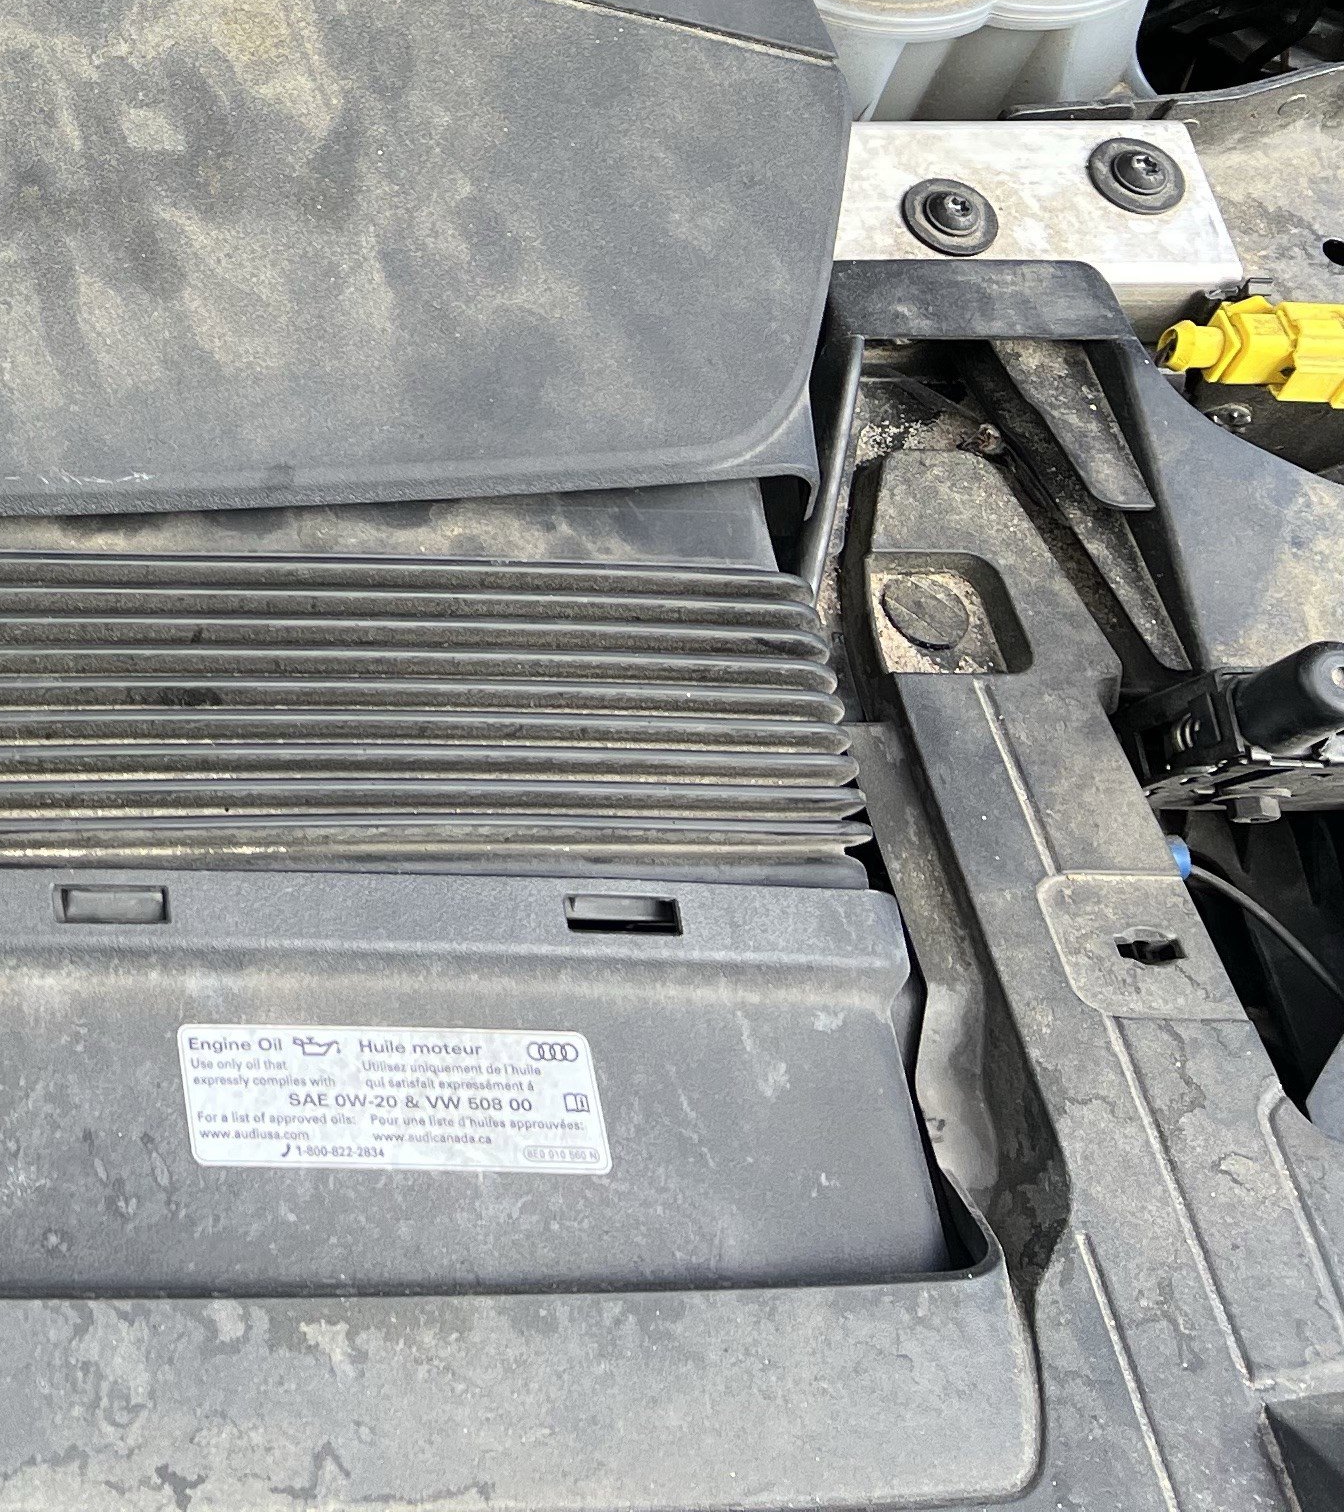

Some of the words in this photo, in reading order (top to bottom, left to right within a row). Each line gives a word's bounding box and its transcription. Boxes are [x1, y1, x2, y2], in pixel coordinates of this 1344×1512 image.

[188, 1037, 252, 1053] Engine
[258, 1037, 283, 1051] Oil
[359, 1039, 406, 1054] Huile
[412, 1043, 482, 1056] moteur
[190, 1058, 213, 1069] Use
[216, 1058, 242, 1071] only
[245, 1058, 261, 1070] oil
[263, 1058, 288, 1070] that
[362, 1061, 407, 1072] Utilisez
[410, 1063, 482, 1076] uniquement
[486, 1064, 501, 1074] de
[193, 1075, 249, 1088] expressly
[252, 1075, 307, 1088] complies
[309, 1076, 336, 1087] with
[365, 1077, 385, 1089] qui
[388, 1078, 435, 1089] satisfait
[438, 1079, 524, 1092] expressément
[288, 1093, 329, 1107] SAE
[334, 1093, 397, 1108] 0W-20
[405, 1095, 419, 1108] &
[425, 1095, 460, 1110] VW
[468, 1097, 503, 1111] 508
[509, 1098, 533, 1111] 00
[197, 1111, 217, 1123] For
[232, 1111, 249, 1123] list
[254, 1111, 266, 1123] of
[269, 1112, 327, 1125] approved
[370, 1115, 399, 1126] Pour
[403, 1117, 425, 1127] une
[429, 1116, 454, 1127] liste
[510, 1119, 584, 1131] approuvées:
[199, 1128, 310, 1140] www.audiusa.com
[373, 1133, 492, 1145] www.audicanada.ca
[296, 1146, 385, 1158] 1-800-822-2834
[548, 1148, 566, 1159] 010
[589, 1150, 597, 1160] N
